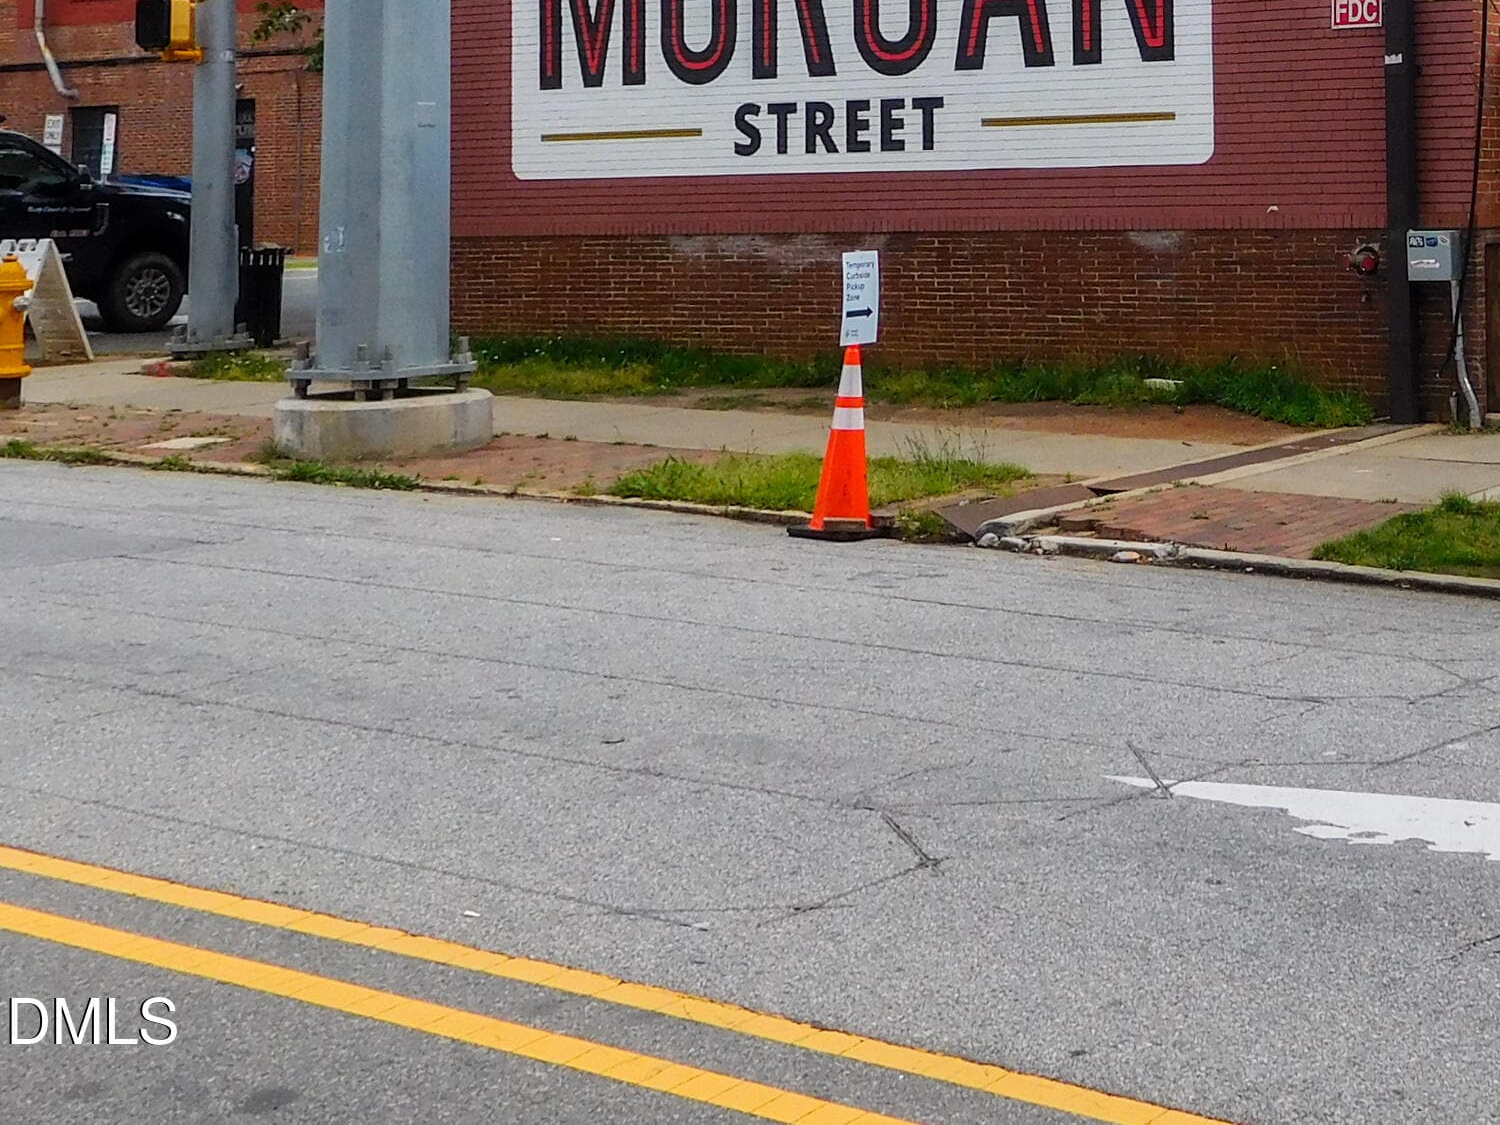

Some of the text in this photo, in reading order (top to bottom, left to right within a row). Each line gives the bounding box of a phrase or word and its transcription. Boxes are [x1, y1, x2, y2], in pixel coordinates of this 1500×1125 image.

[734, 96, 943, 156] STREET
[846, 261, 875, 269] Temporary
[846, 272, 870, 280] Curbside
[846, 283, 865, 291] Pickup
[846, 294, 860, 302] Zone
